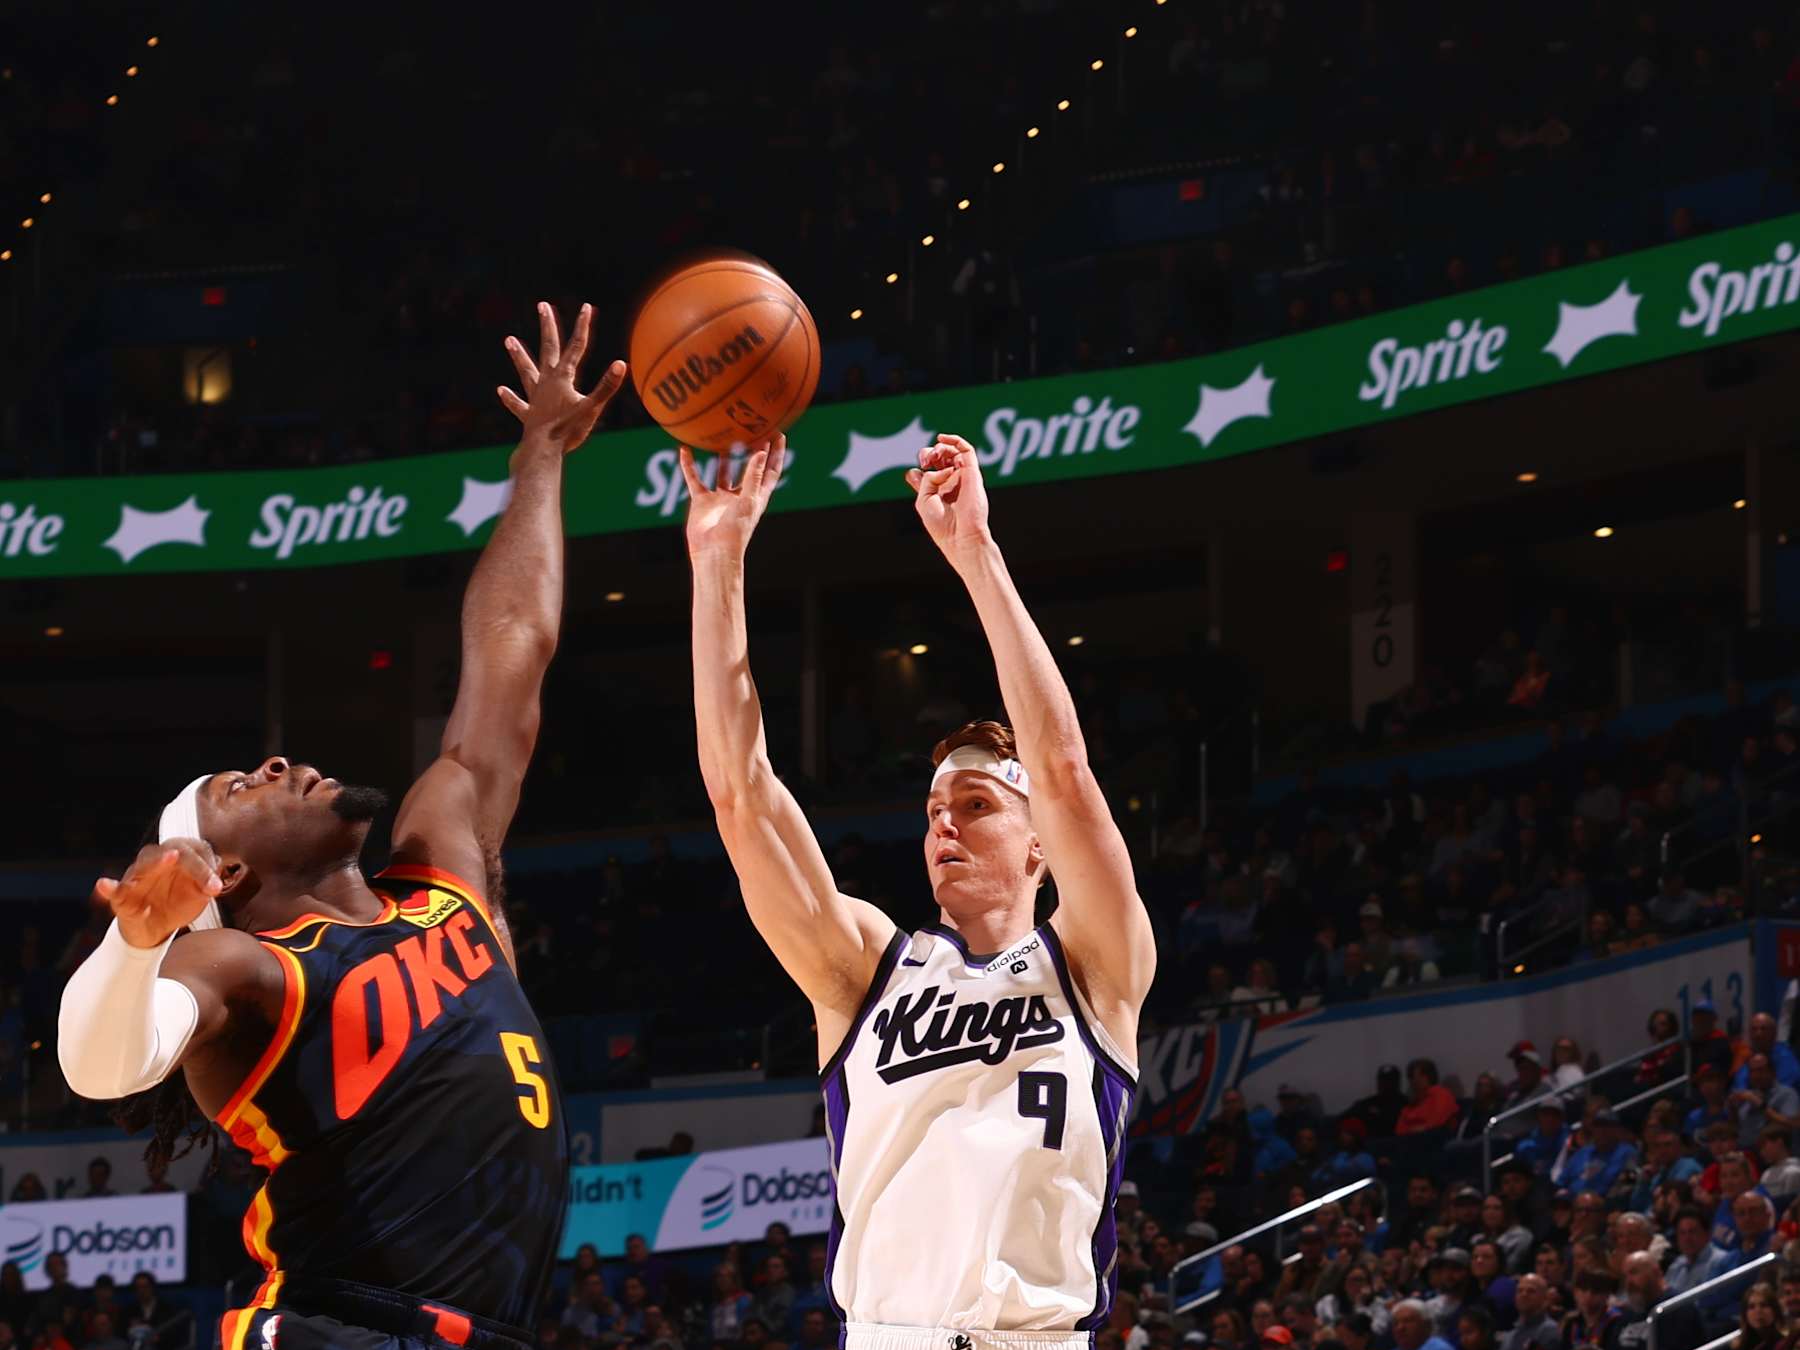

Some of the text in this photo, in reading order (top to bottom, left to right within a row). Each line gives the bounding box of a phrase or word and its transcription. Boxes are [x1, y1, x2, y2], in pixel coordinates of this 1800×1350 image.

[1679, 242, 1800, 337] Sprit
[652, 325, 765, 412] Wilson
[1359, 319, 1507, 409] Sprite
[976, 396, 1140, 475] Sprite
[0, 503, 64, 555] ite
[249, 486, 407, 559] Sprite
[987, 938, 1040, 972] dialpad
[331, 910, 495, 1121] OKC
[873, 985, 1062, 1072] Kings
[500, 1032, 549, 1129] 5
[1018, 1071, 1068, 1150] 9
[742, 1167, 831, 1207] Dobso
[53, 1221, 175, 1255] Dobson
